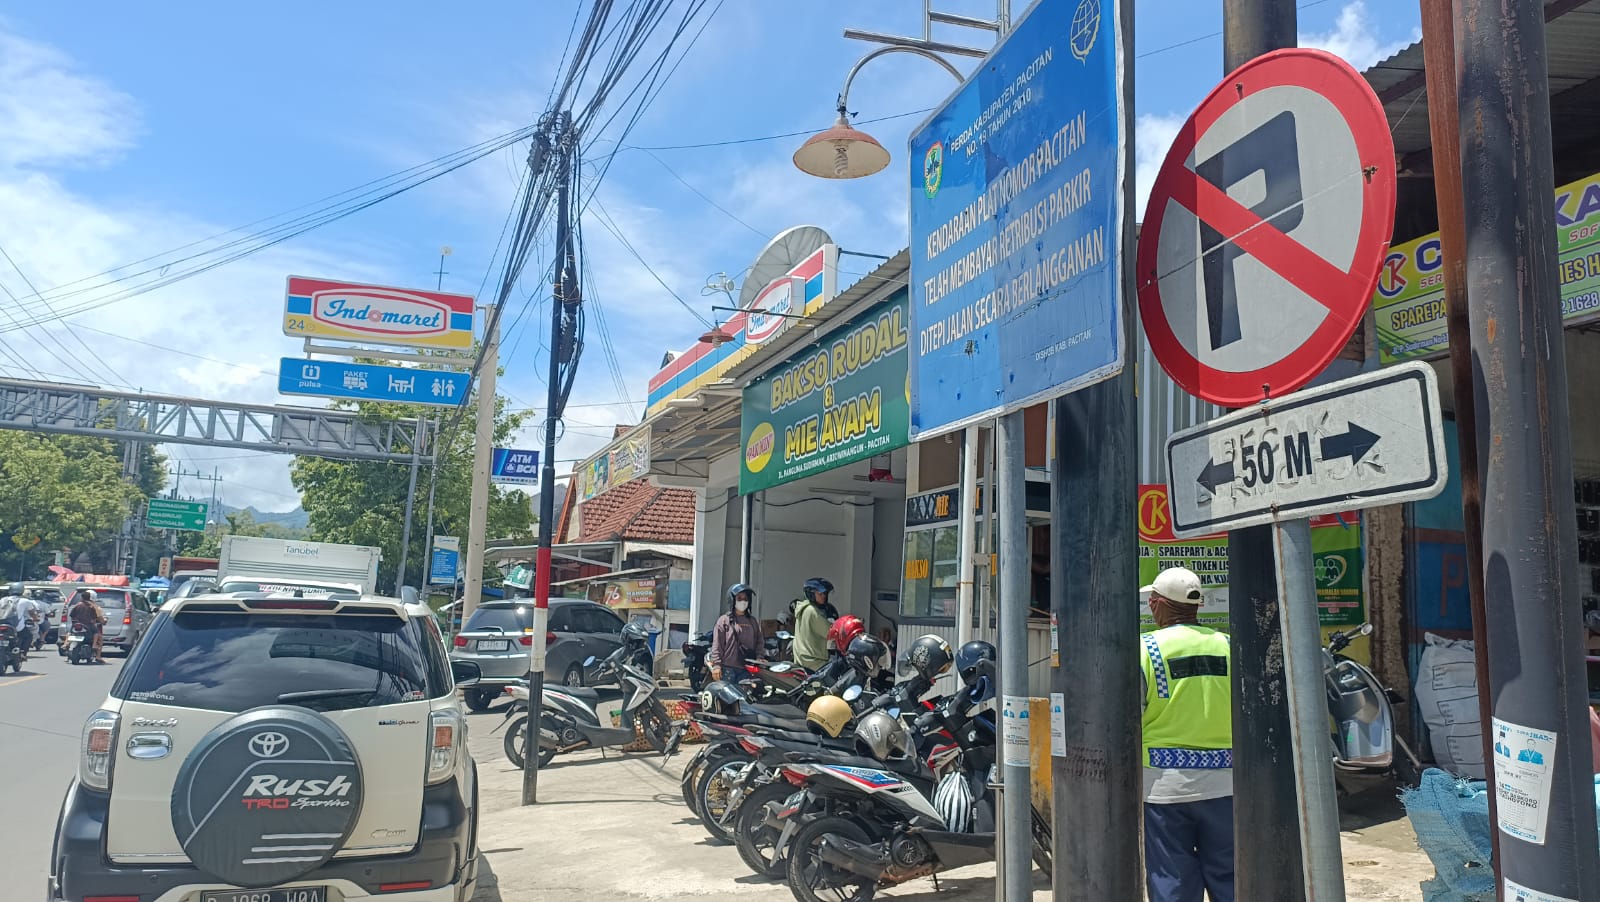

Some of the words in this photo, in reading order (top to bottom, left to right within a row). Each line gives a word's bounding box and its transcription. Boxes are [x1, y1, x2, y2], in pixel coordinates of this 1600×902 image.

[950, 124, 973, 156] PERDA
[973, 83, 1015, 133] KABUPATEN
[1016, 47, 1053, 91] PACITAN
[966, 143, 978, 158] NO.
[988, 108, 1012, 139] TAHUN
[1012, 88, 1032, 116] 2010
[927, 201, 977, 262] KENDARAAN
[977, 183, 999, 226] PLAT
[999, 156, 1036, 209] NOMOR
[1036, 110, 1087, 178] PACITAN
[924, 271, 950, 307] TELAH
[950, 235, 999, 290] MEMBAYAR
[999, 199, 1048, 262] RETRIBUSI
[1049, 167, 1092, 226] PARKIR
[920, 321, 946, 356] DITEPI
[946, 306, 974, 343] JALAN
[975, 286, 1010, 330] SECARA
[1011, 226, 1104, 311] BERLANGGANAN
[1568, 291, 1600, 313] 1628
[288, 319, 305, 331] 24
[323, 299, 441, 329] Indomaret
[1035, 346, 1055, 361] DISHUB
[1067, 329, 1092, 347] PACITAN
[771, 349, 829, 412] BAKSO
[832, 309, 907, 379] RUDAL
[298, 381, 322, 389] pulsa
[343, 370, 369, 379] PAKET
[823, 384, 835, 408] &
[785, 421, 818, 462] MIE
[820, 392, 880, 446] AYAM
[867, 434, 890, 451] PACITAN
[509, 453, 533, 464] ATM
[516, 464, 537, 474] BCA
[1241, 440, 1275, 489] 50
[1283, 431, 1313, 479] M
[1158, 546, 1205, 557] SPAREPART
[1207, 547, 1213, 556] &
[1191, 560, 1217, 571] TOKEN
[131, 717, 178, 727] Rush
[242, 774, 353, 796] Rush
[241, 797, 290, 810] TRD
[290, 797, 350, 810] Sportivo
